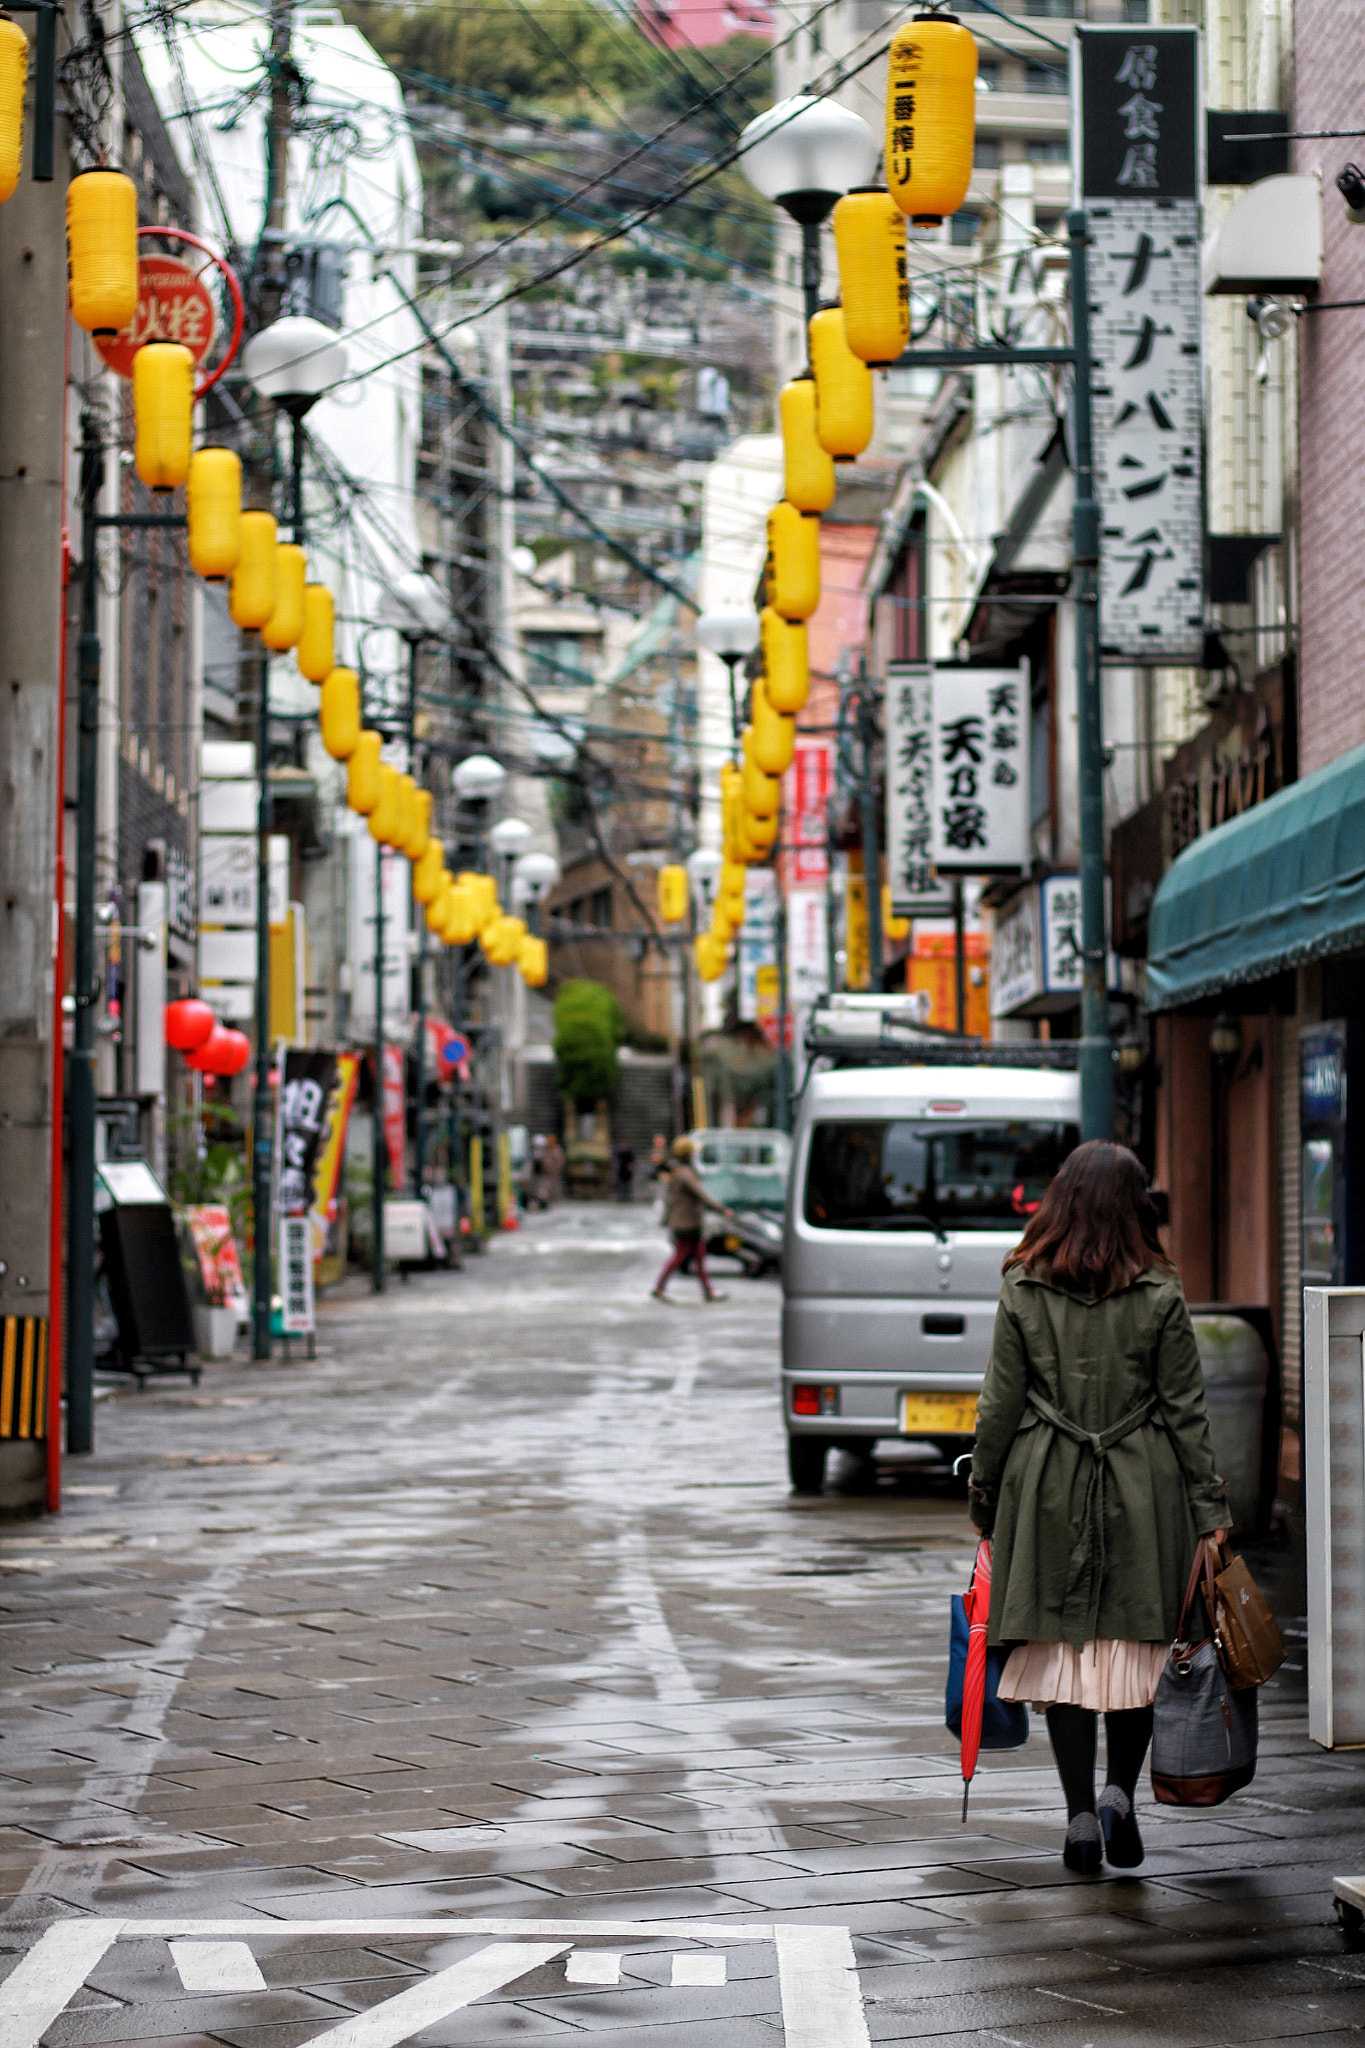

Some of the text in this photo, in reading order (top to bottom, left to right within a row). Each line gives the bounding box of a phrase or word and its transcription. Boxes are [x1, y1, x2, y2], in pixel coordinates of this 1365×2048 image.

[1114, 44, 1164, 189] 居食屋
[1108, 232, 1176, 598] ナナバンチ
